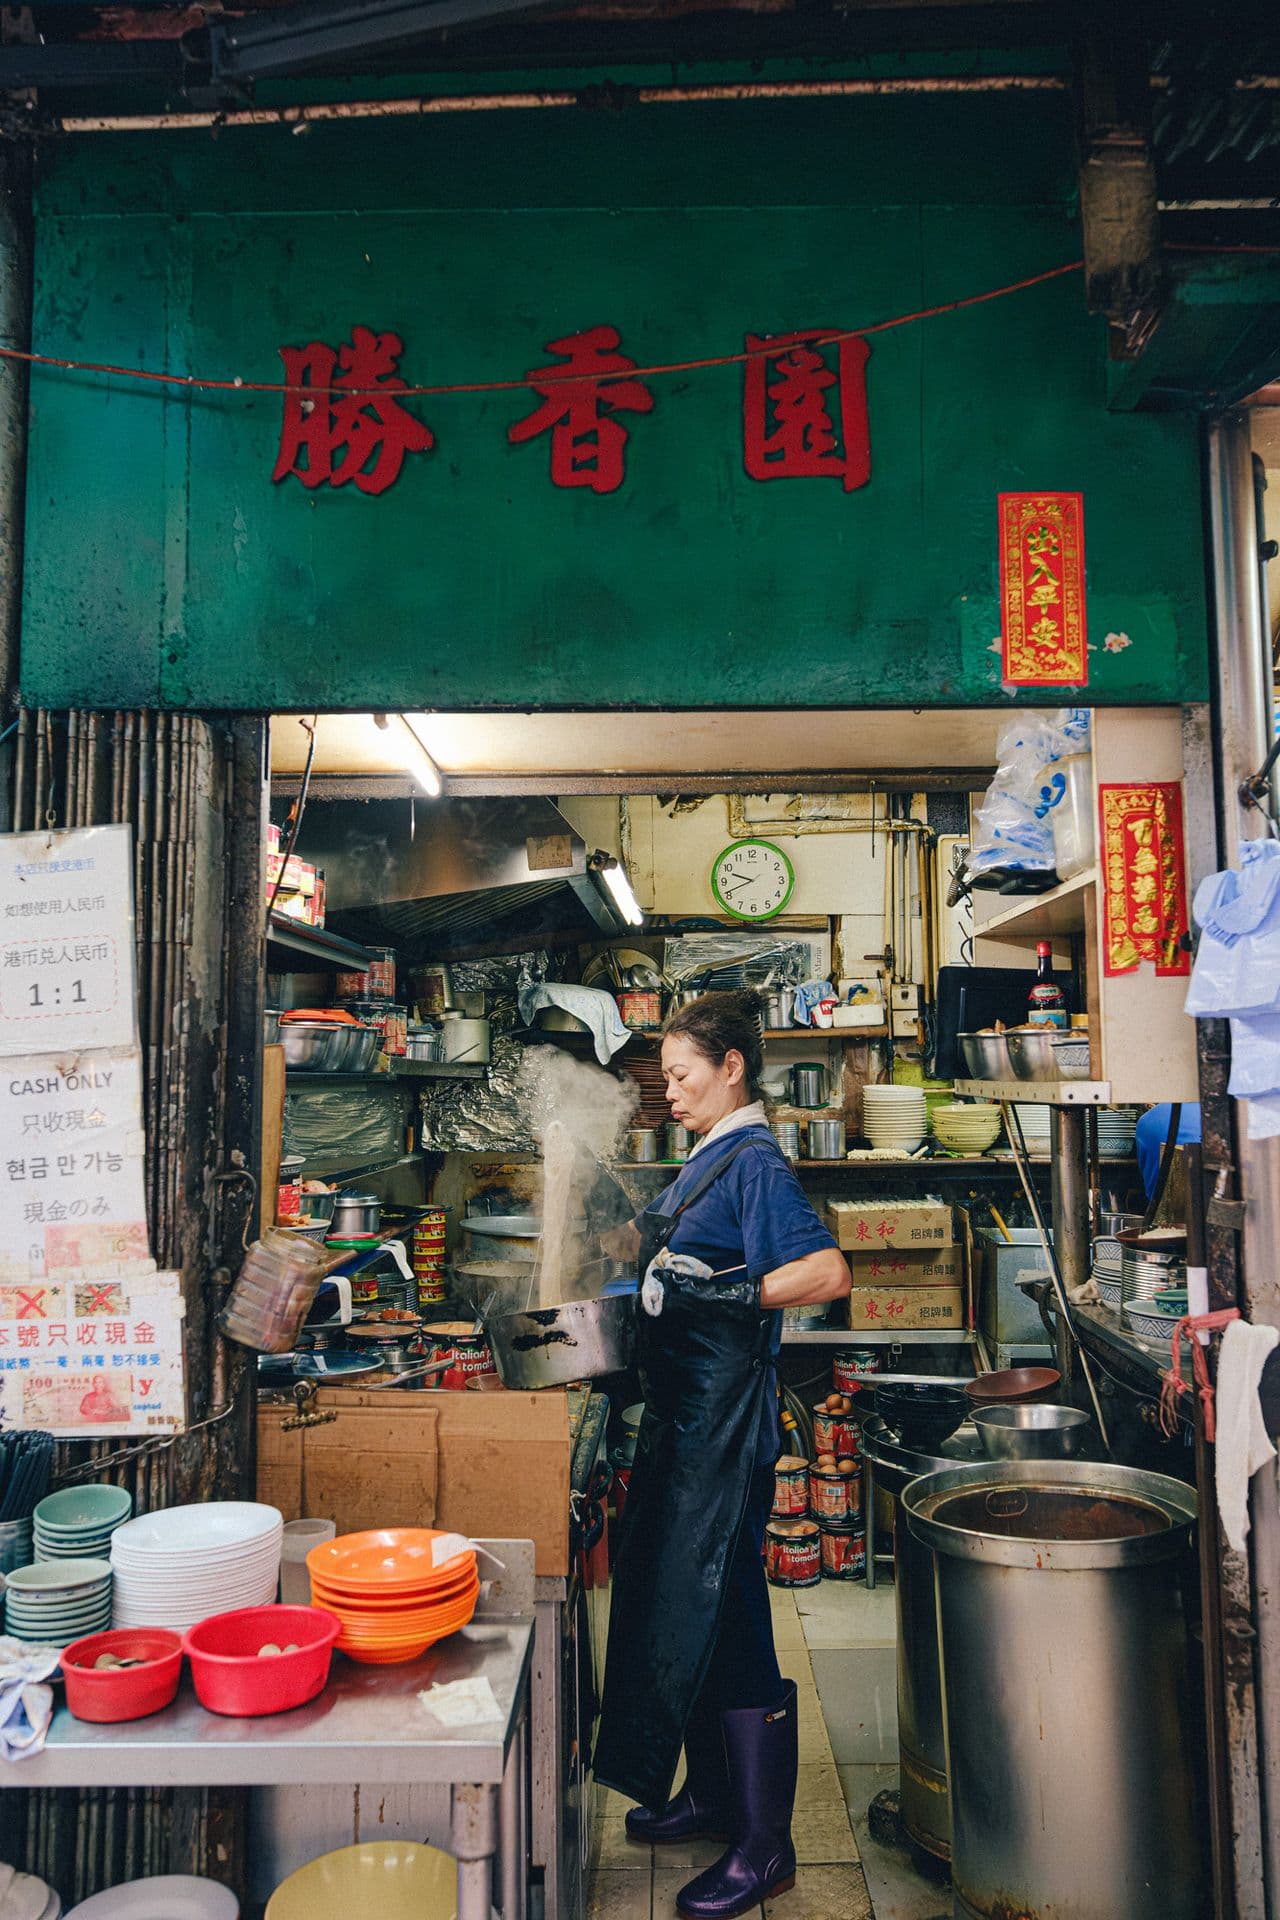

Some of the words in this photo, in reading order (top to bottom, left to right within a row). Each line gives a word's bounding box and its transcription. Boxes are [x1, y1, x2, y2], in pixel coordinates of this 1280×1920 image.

[272, 325, 871, 494] 勝香園
[1027, 526, 1062, 649] 出入平安
[734, 854, 742, 862] 11
[747, 849, 757, 858] 12
[724, 863, 733, 872] 10
[773, 862, 781, 871] 2
[720, 877, 728, 887] 9
[778, 876, 785, 885] 3
[726, 891, 733, 900] 8
[774, 890, 781, 898] 4
[737, 901, 744, 910] 7
[750, 904, 757, 913] 6
[764, 900, 771, 909] 5
[4, 942, 108, 968] 港币兑人民币
[10, 1077, 60, 1096] CASH
[66, 1072, 113, 1091] ONLY
[21, 1107, 107, 1135] 只收現金
[6, 1157, 49, 1181] 현금
[57, 1153, 77, 1177] 만
[83, 1151, 124, 1174] 가능
[23, 1196, 111, 1223] 現金のみ
[855, 1219, 897, 1242] 東和
[864, 1299, 905, 1321] 東和
